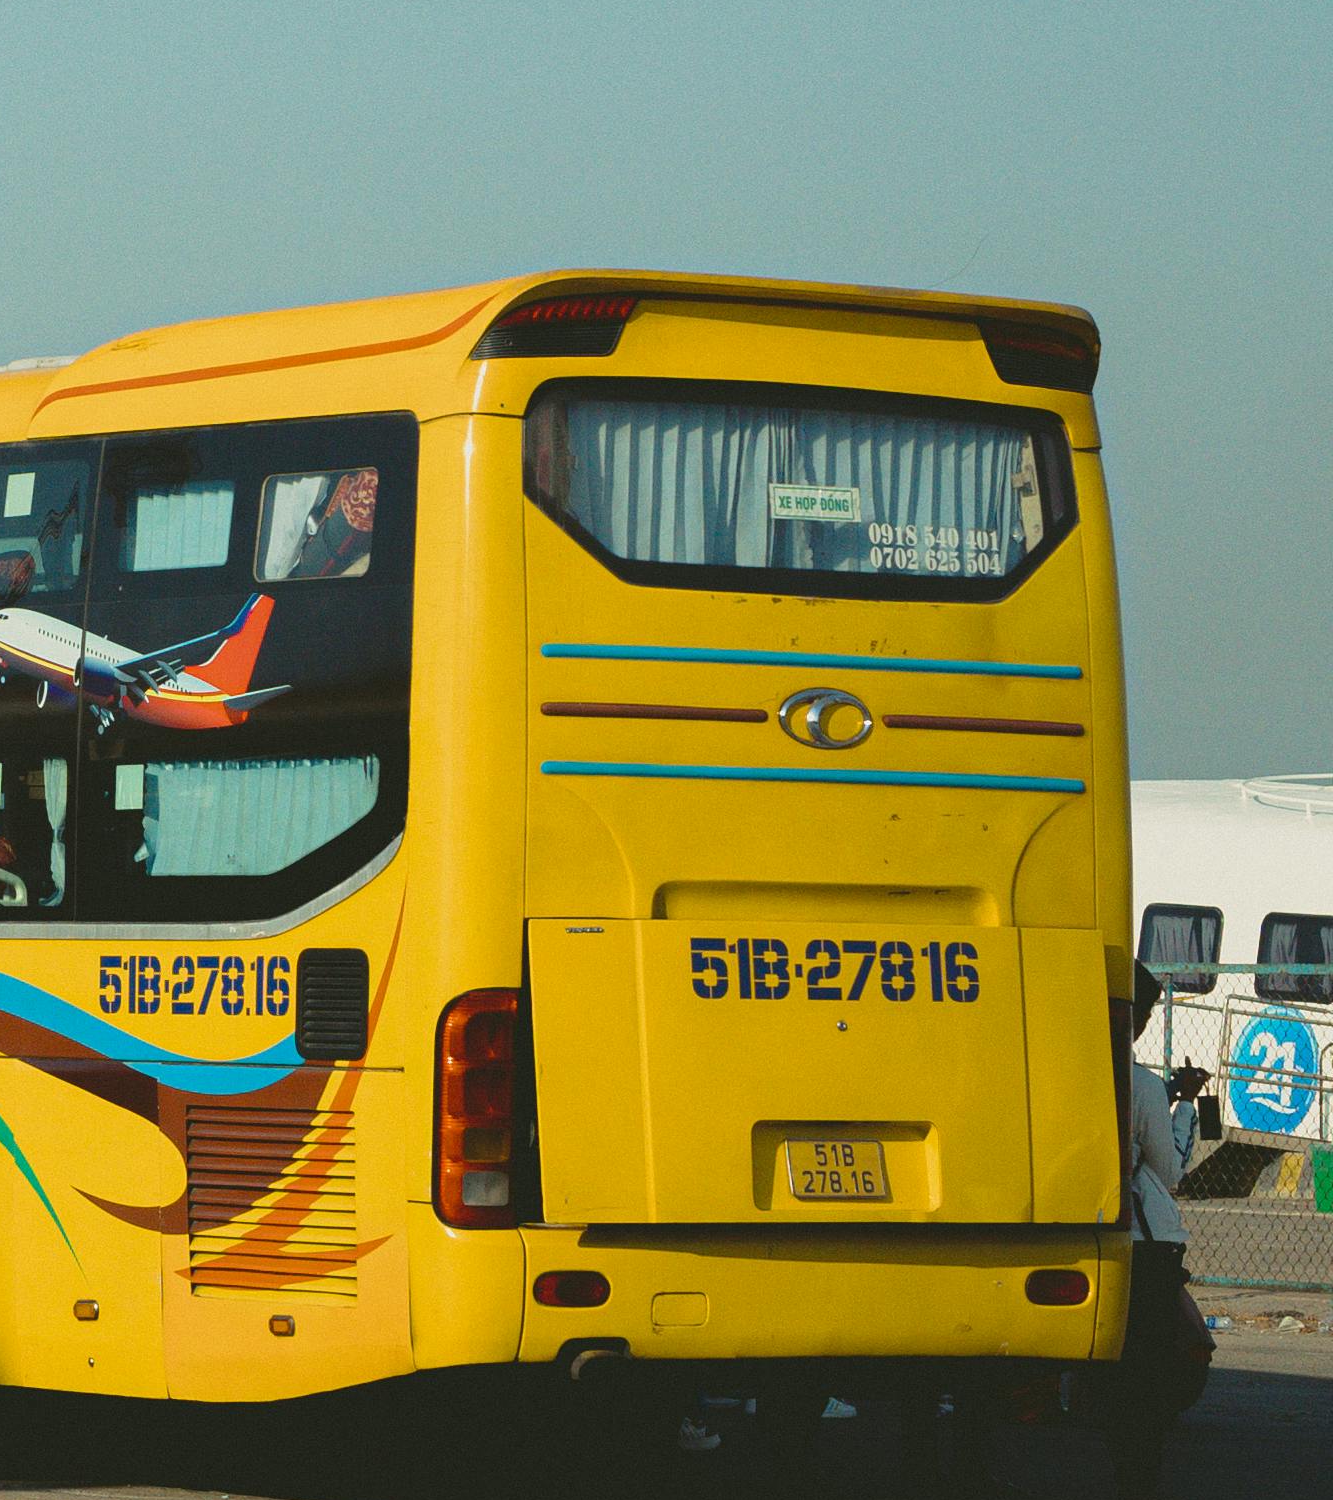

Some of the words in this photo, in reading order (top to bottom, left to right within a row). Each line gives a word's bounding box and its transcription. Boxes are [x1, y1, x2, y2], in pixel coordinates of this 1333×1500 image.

[778, 495, 792, 509] XE
[868, 522, 918, 547] 0918
[924, 526, 959, 549] 540
[966, 529, 1000, 552] 401
[870, 546, 919, 570] 0702
[925, 549, 961, 573] 625
[966, 552, 1005, 576] 504
[690, 938, 980, 1002] 51B-27816
[99, 955, 290, 1016] 51B-278.16
[814, 1143, 855, 1167] 51B
[802, 1170, 875, 1193] 278.16
